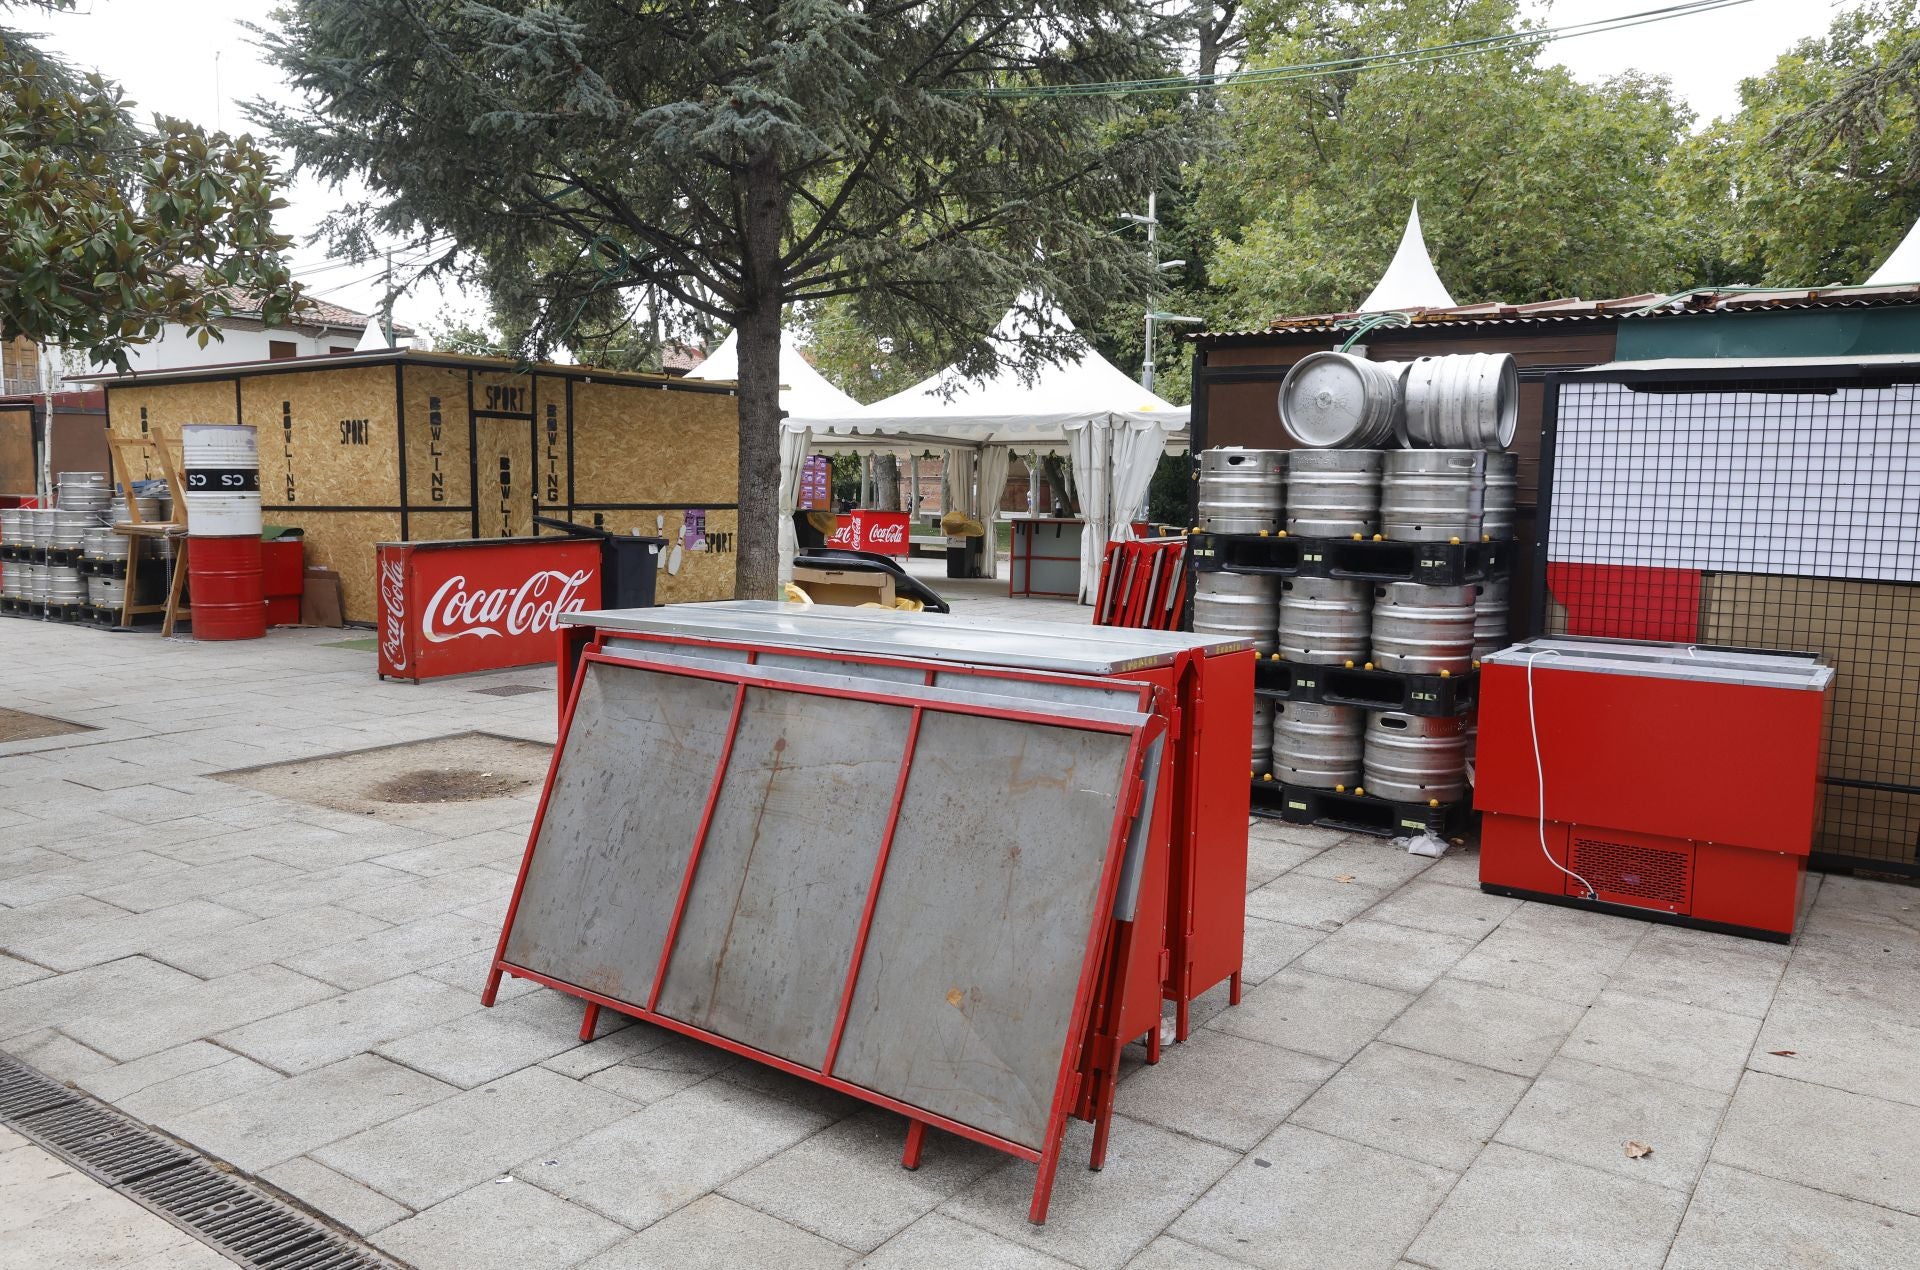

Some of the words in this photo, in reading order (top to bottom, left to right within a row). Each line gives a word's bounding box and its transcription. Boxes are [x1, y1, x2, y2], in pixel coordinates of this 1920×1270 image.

[340, 419, 368, 445] SPORT
[486, 386, 525, 411] SPORT
[283, 401, 295, 501] BOWLING
[430, 397, 443, 501] BOWLING
[547, 404, 558, 501] BOWLING
[500, 457, 512, 537] BOWLIN
[869, 524, 904, 543] Coca-Cola
[705, 533, 733, 553] SPORT
[381, 556, 407, 671] Coca-Cola
